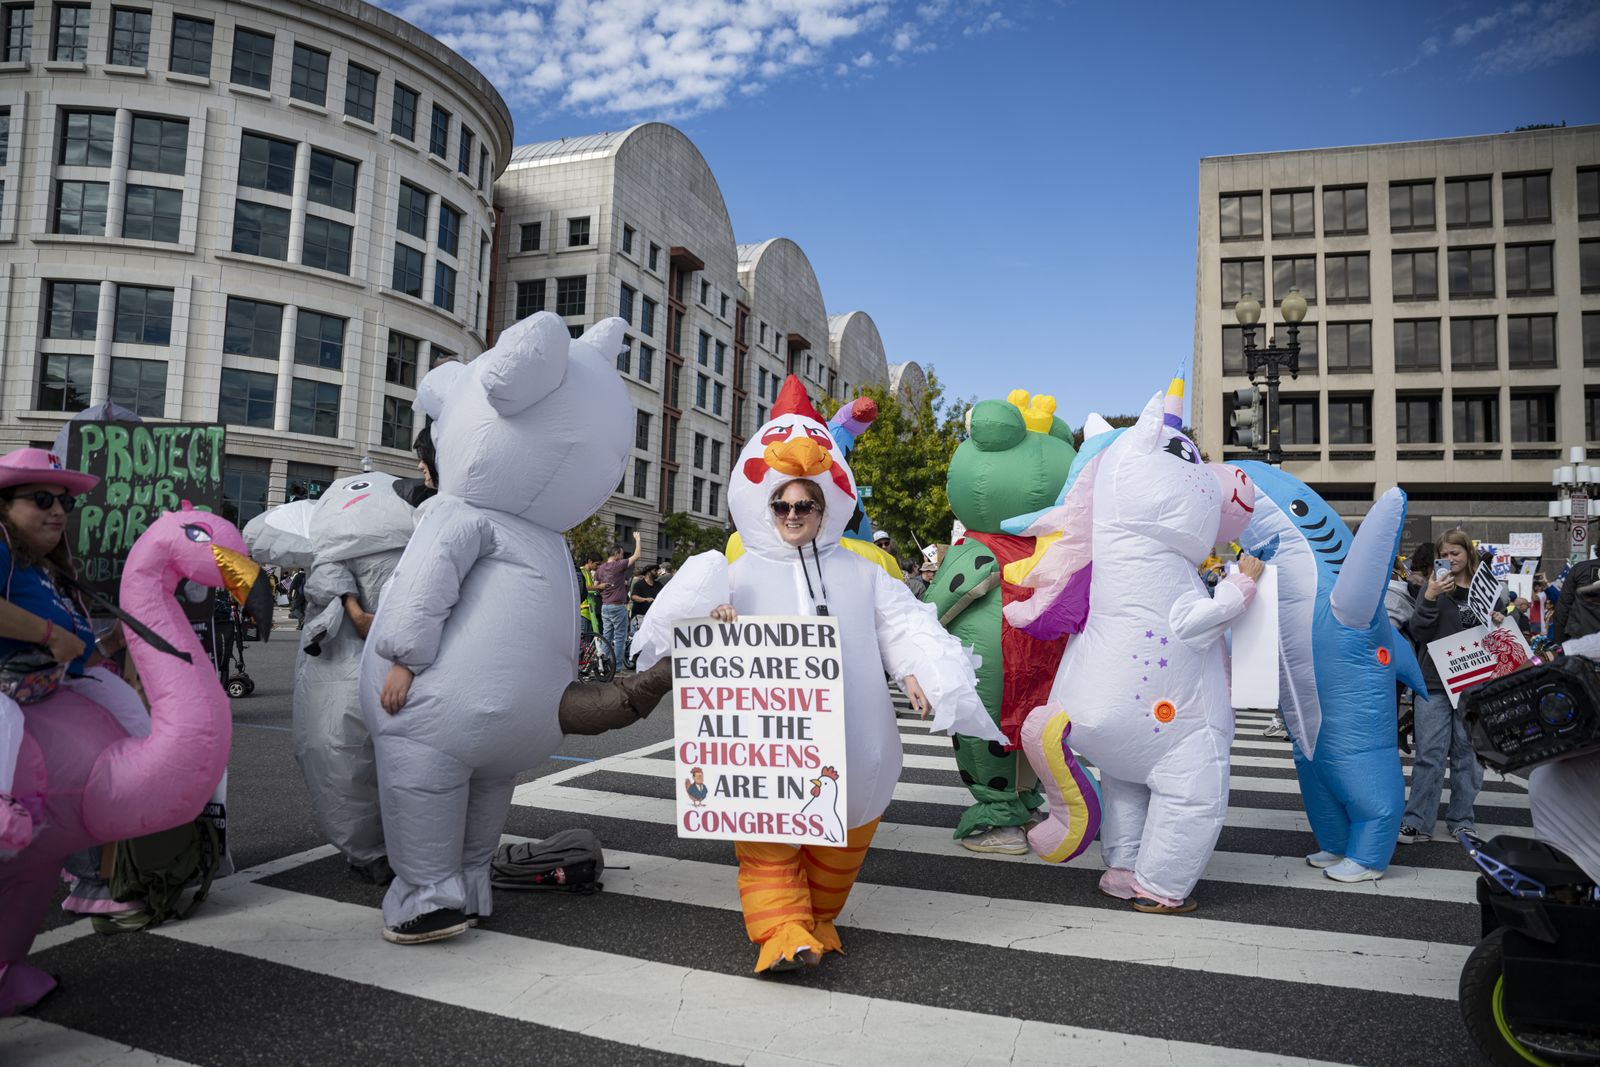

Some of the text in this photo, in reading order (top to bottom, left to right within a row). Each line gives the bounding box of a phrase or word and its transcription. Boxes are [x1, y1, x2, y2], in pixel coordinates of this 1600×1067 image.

[79, 424, 225, 484] PROTECT
[105, 479, 179, 508] OUR
[674, 623, 836, 648] NO WONDER
[674, 656, 840, 680] EGGS ARE SO
[1448, 655, 1491, 674] YOUR OATH
[1449, 650, 1485, 666] REMEMBER
[680, 687, 832, 713] EXPENSIVE
[697, 715, 813, 741] ALL THE
[679, 742, 821, 769] CHICKENS
[714, 775, 804, 800] ARE IN
[683, 810, 824, 837] CONGRESS
